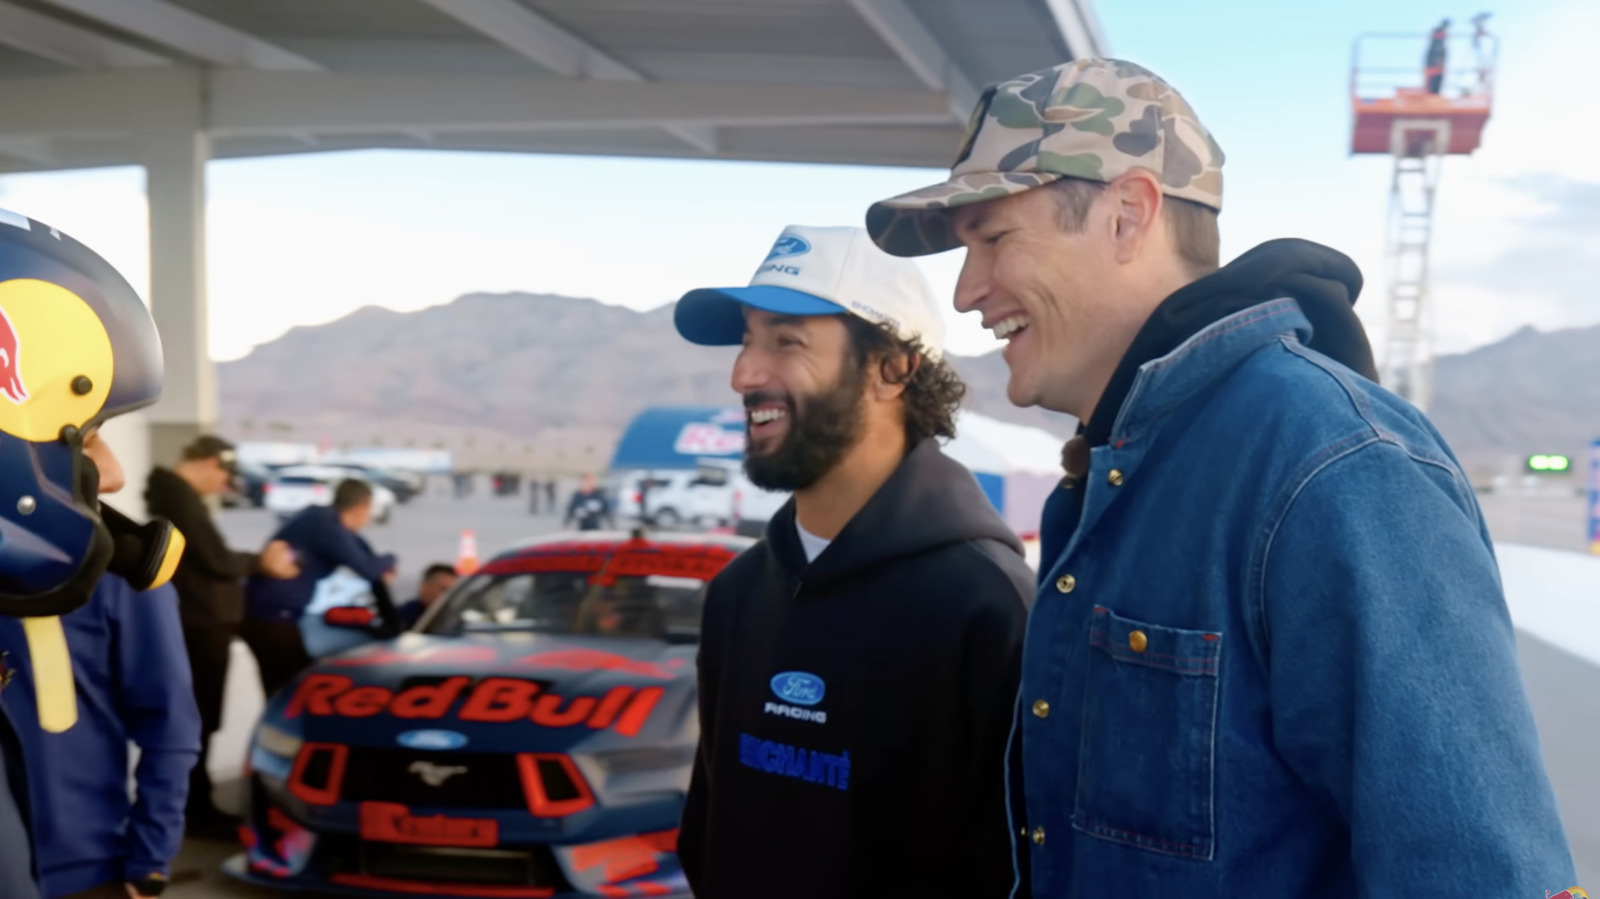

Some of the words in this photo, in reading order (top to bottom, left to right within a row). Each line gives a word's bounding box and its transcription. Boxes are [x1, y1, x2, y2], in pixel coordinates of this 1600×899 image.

[757, 263, 801, 276] NG
[676, 422, 745, 455] Re
[285, 674, 471, 719] Red
[460, 677, 664, 737] Bull
[764, 702, 827, 724] RACING
